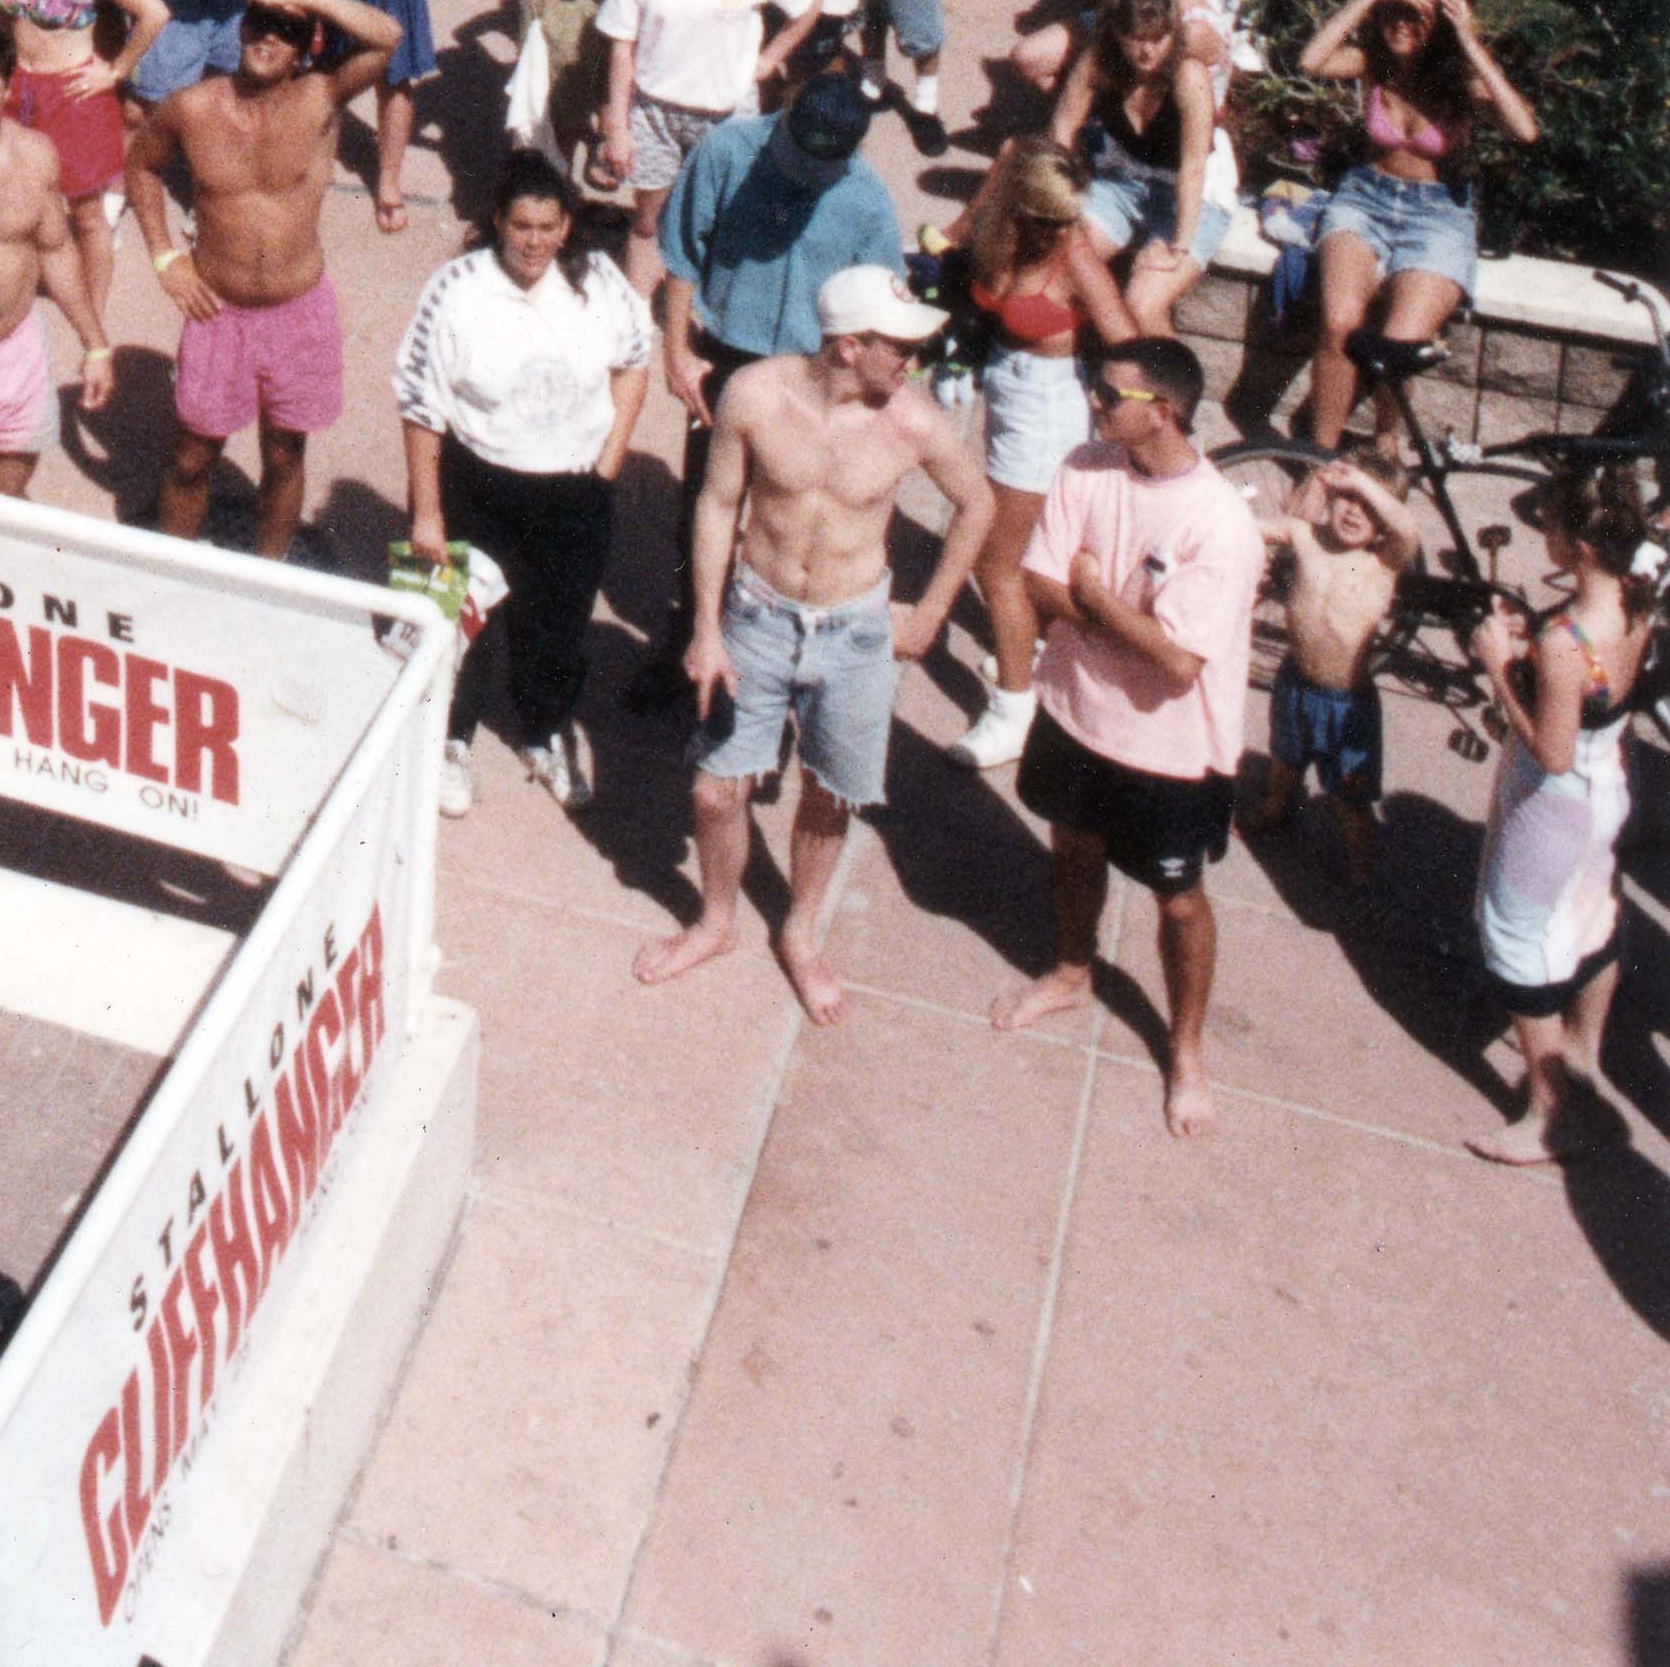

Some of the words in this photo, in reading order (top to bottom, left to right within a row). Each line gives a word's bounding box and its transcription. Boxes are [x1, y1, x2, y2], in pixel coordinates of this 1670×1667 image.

[14, 747, 109, 793] HANG
[139, 786, 198, 821] ON!
[78, 900, 385, 1628] CLIFFHANGER
[130, 922, 338, 1335] STALLONE
